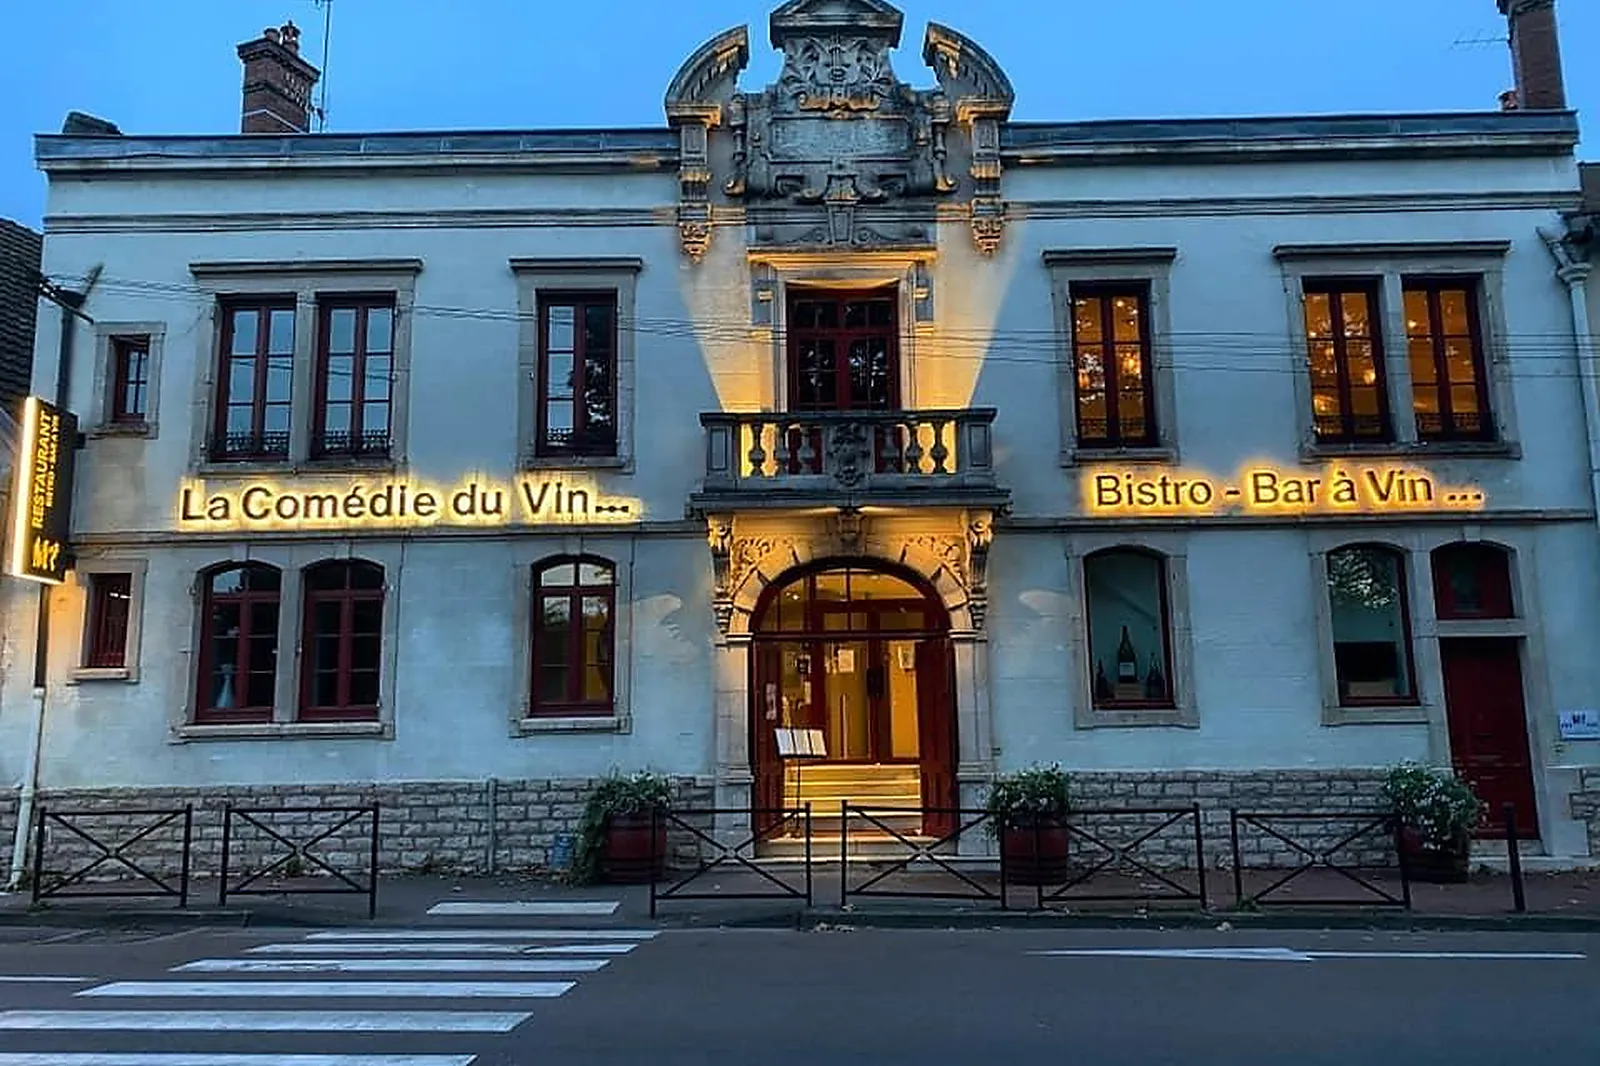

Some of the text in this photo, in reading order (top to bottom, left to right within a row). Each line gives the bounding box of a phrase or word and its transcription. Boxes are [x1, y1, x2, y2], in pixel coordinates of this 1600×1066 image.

[32, 409, 51, 529] RESTAURANT
[182, 488, 230, 521] La
[241, 485, 437, 520] Comédie
[452, 483, 502, 516] du
[1096, 474, 1213, 507] Bistro
[1253, 472, 1321, 504] Bar
[1332, 470, 1357, 503] à
[1366, 470, 1433, 502] Vin
